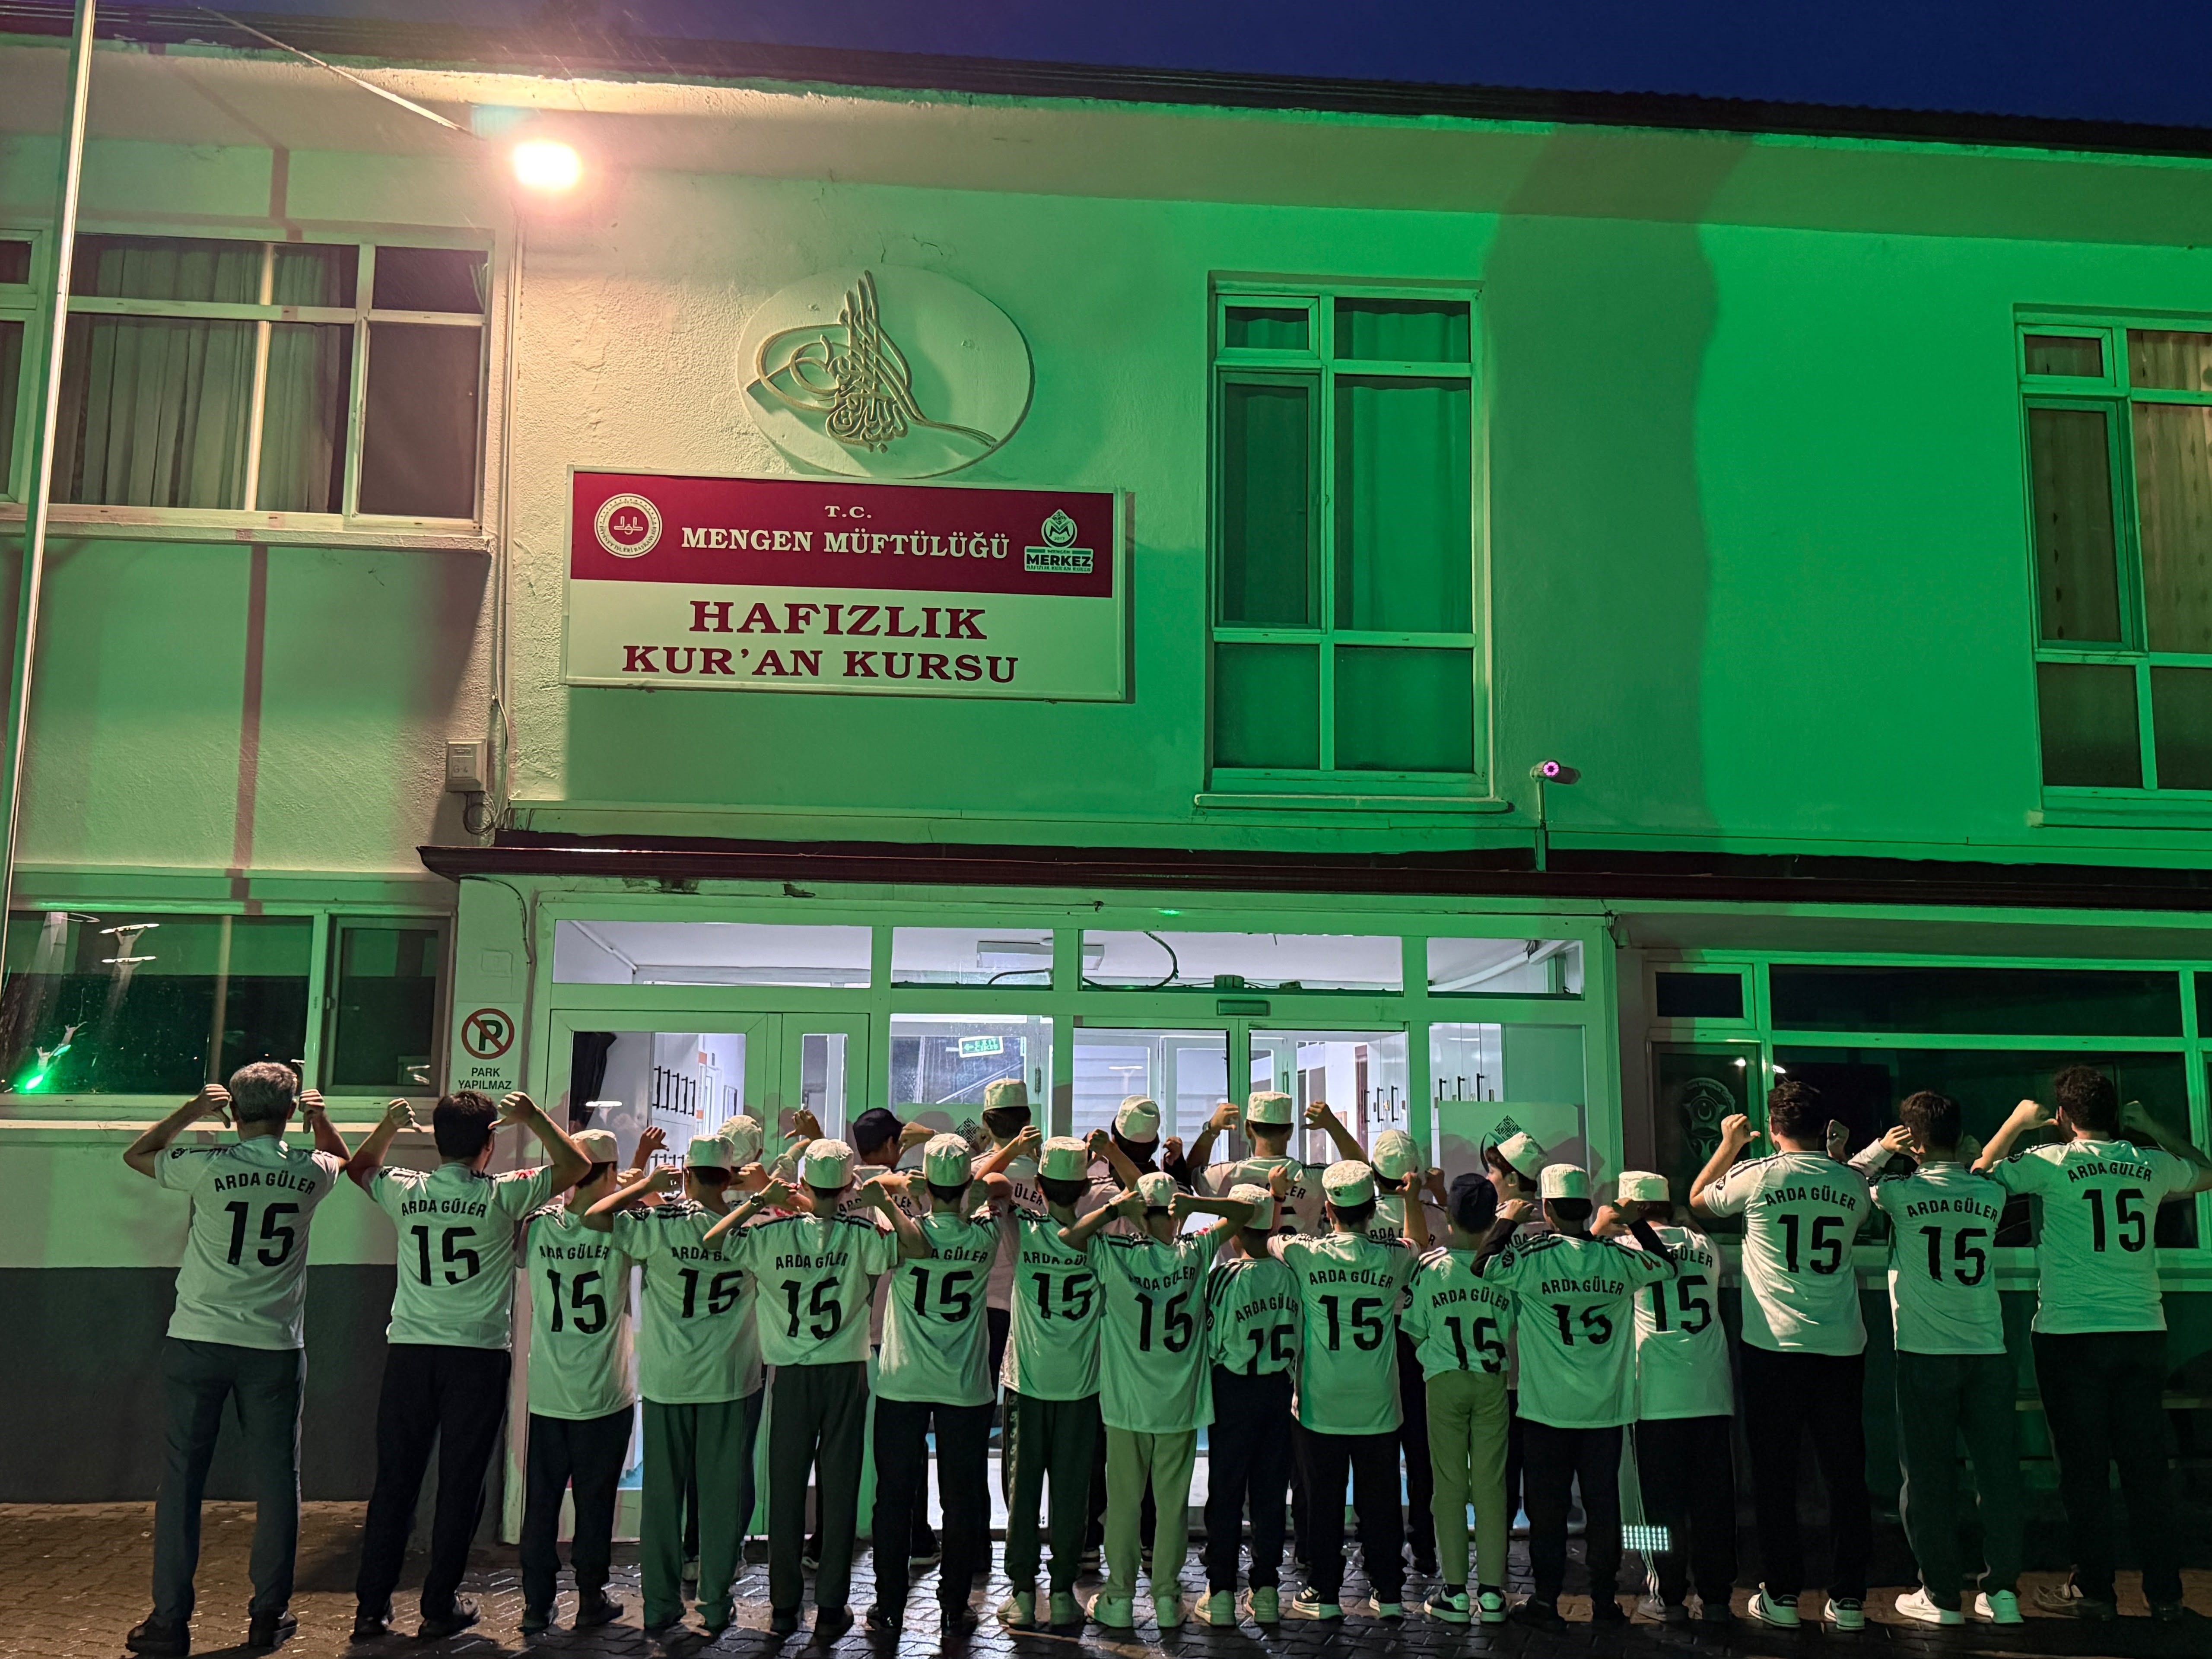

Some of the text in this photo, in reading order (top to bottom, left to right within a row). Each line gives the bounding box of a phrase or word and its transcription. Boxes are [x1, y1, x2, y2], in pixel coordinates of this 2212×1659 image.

[824, 505, 872, 518] T.C.
[681, 527, 1010, 559] MENGEN MÜFTÜLÜĞÜ
[1027, 554, 1091, 567] MERKEZ
[689, 601, 987, 640] HAFIZLIK
[622, 645, 1019, 683] KUR'AN KURSU
[458, 1080, 512, 1090] YAPILMAZ
[471, 1068, 500, 1077] PARK
[214, 1170, 316, 1195] ARDA GÜLER
[2067, 1162, 2107, 1183] ARDA
[401, 1198, 487, 1218] ARDA GÜLER
[1764, 1184, 1856, 1211] ARDA GÜLER
[1907, 1197, 1998, 1223] ARDA GÜLER
[224, 1201, 299, 1267] 15
[2082, 1188, 2146, 1252] 15
[410, 1225, 480, 1286] 15
[567, 1243, 610, 1260] GÜLER
[671, 1246, 709, 1261] ARDA
[944, 1246, 988, 1263] GÜLER
[1777, 1214, 1844, 1274] 15
[1919, 1225, 1988, 1286] 15
[775, 1254, 812, 1270] ARDA
[1309, 1269, 1347, 1285] ARDA
[547, 1268, 607, 1334] 15
[677, 1268, 744, 1318] 15
[909, 1266, 975, 1323] 15
[1031, 1272, 1093, 1321] 15
[1432, 1286, 1510, 1312] ARDA GÜLER
[1541, 1275, 1624, 1296] ARDA GÜLER
[780, 1276, 842, 1341] 15
[1235, 1298, 1268, 1323] ARDA
[1645, 1275, 1713, 1335] 15
[1134, 1290, 1193, 1353] 15
[1318, 1294, 1384, 1351] 15
[1550, 1303, 1613, 1346] 15
[1444, 1316, 1506, 1375] 15
